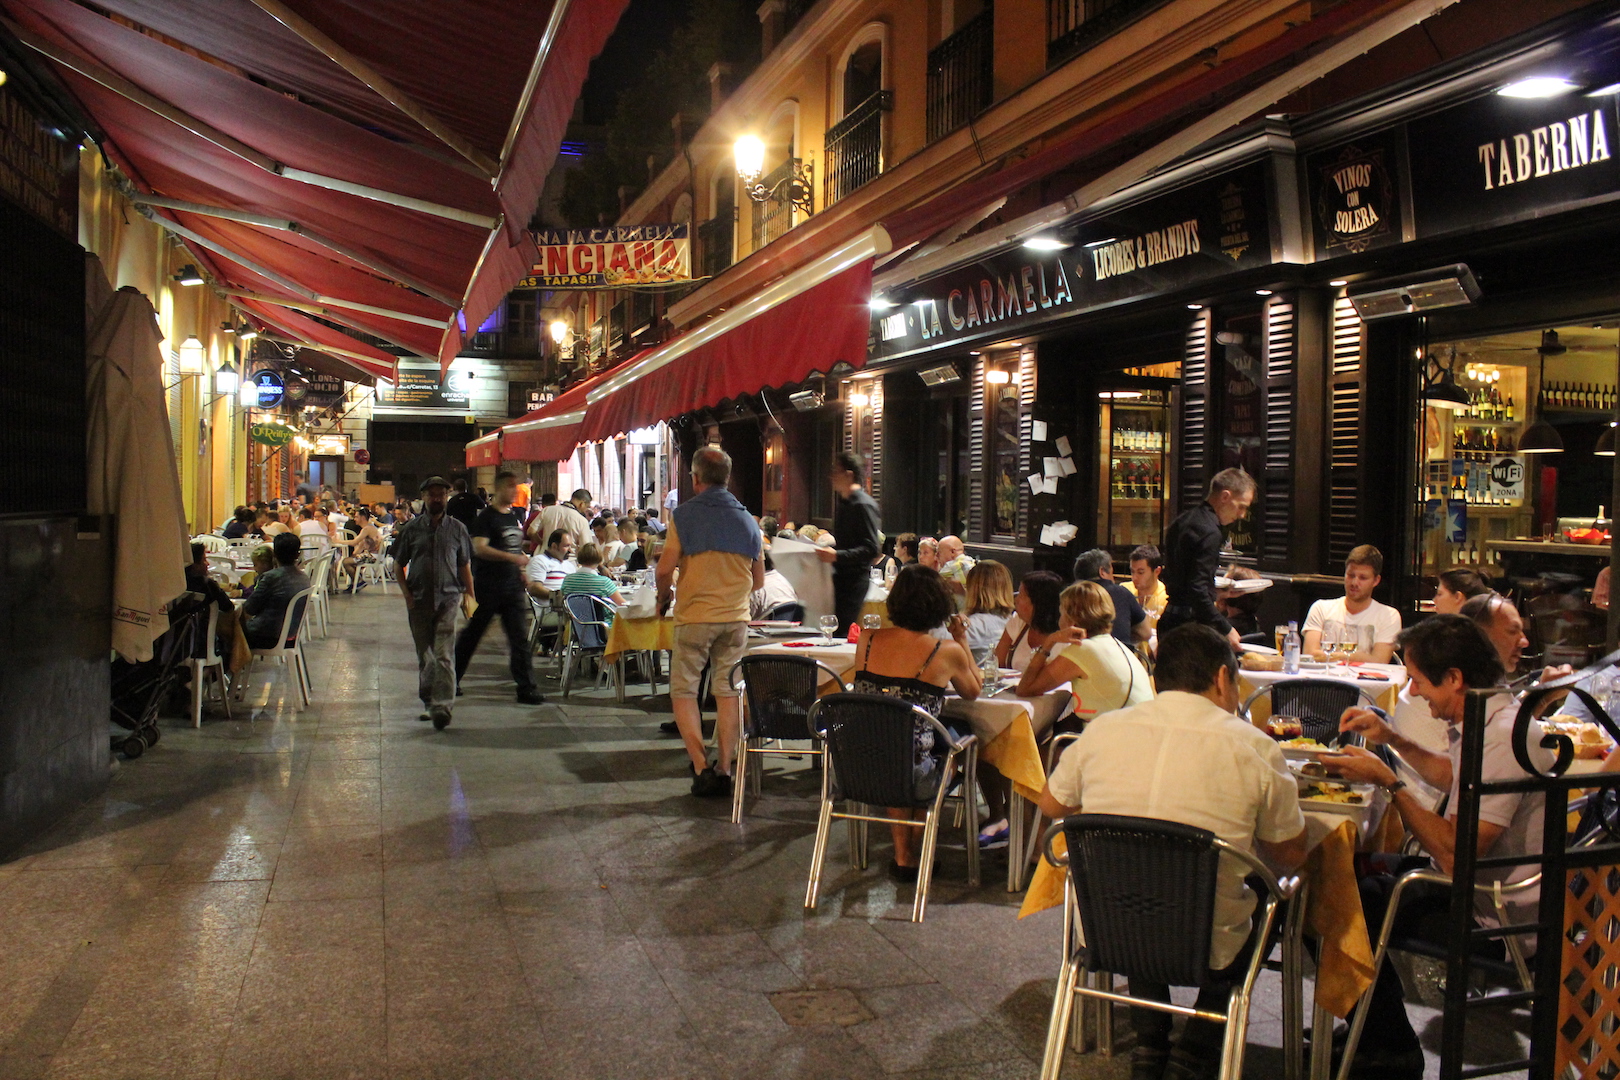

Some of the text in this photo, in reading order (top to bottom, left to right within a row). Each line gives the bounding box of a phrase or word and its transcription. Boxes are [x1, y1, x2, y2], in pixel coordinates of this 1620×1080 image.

[1478, 109, 1611, 191] TABERNA
[1333, 164, 1372, 194] VINOS
[1346, 191, 1360, 208] CON
[1334, 203, 1380, 233] SOLERA
[530, 225, 676, 245] NA LA CARMELA
[1093, 239, 1136, 281] LICORES
[1136, 236, 1146, 268] &
[1145, 219, 1200, 267] BRANDYS
[543, 275, 597, 286] TAPAS!!
[919, 299, 944, 340] LA
[948, 257, 1073, 332] CARMELA
[531, 392, 554, 402] BAR
